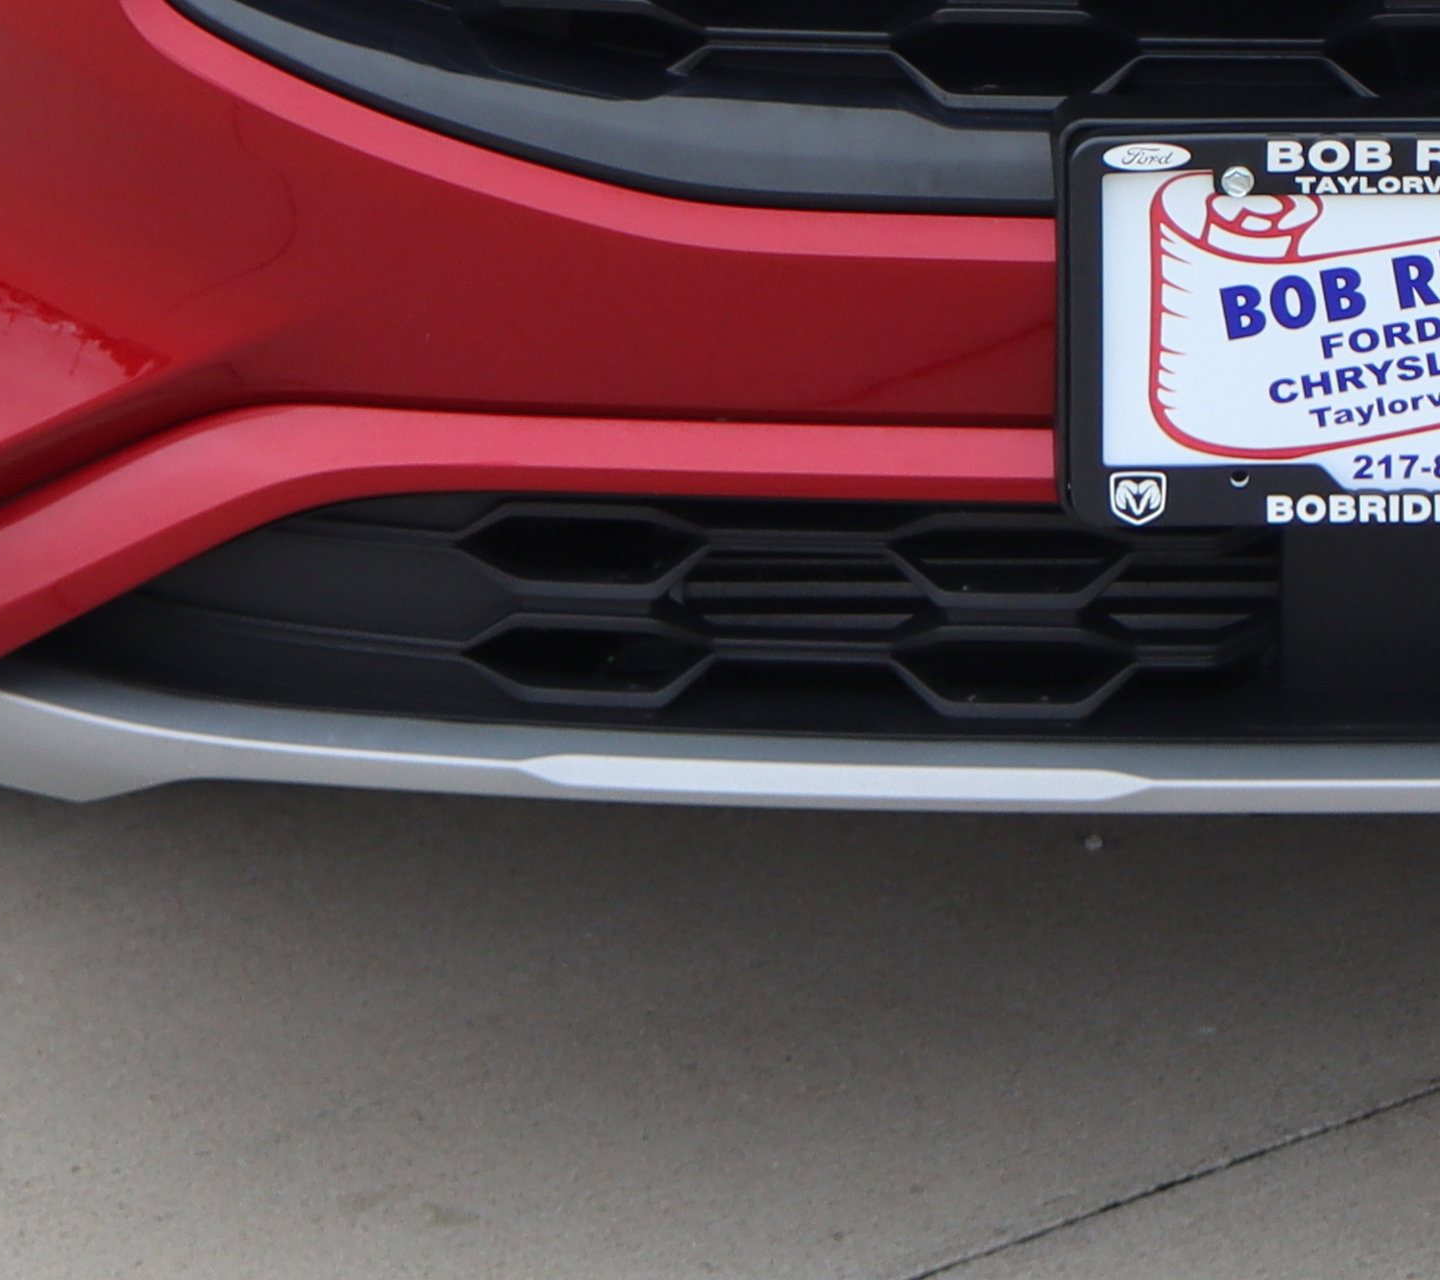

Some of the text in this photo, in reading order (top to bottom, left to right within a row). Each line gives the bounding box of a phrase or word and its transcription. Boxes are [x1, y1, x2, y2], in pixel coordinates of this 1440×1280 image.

[1121, 146, 1174, 167] Ford
[1266, 139, 1393, 173] BOB
[1219, 266, 1367, 341] BOB
